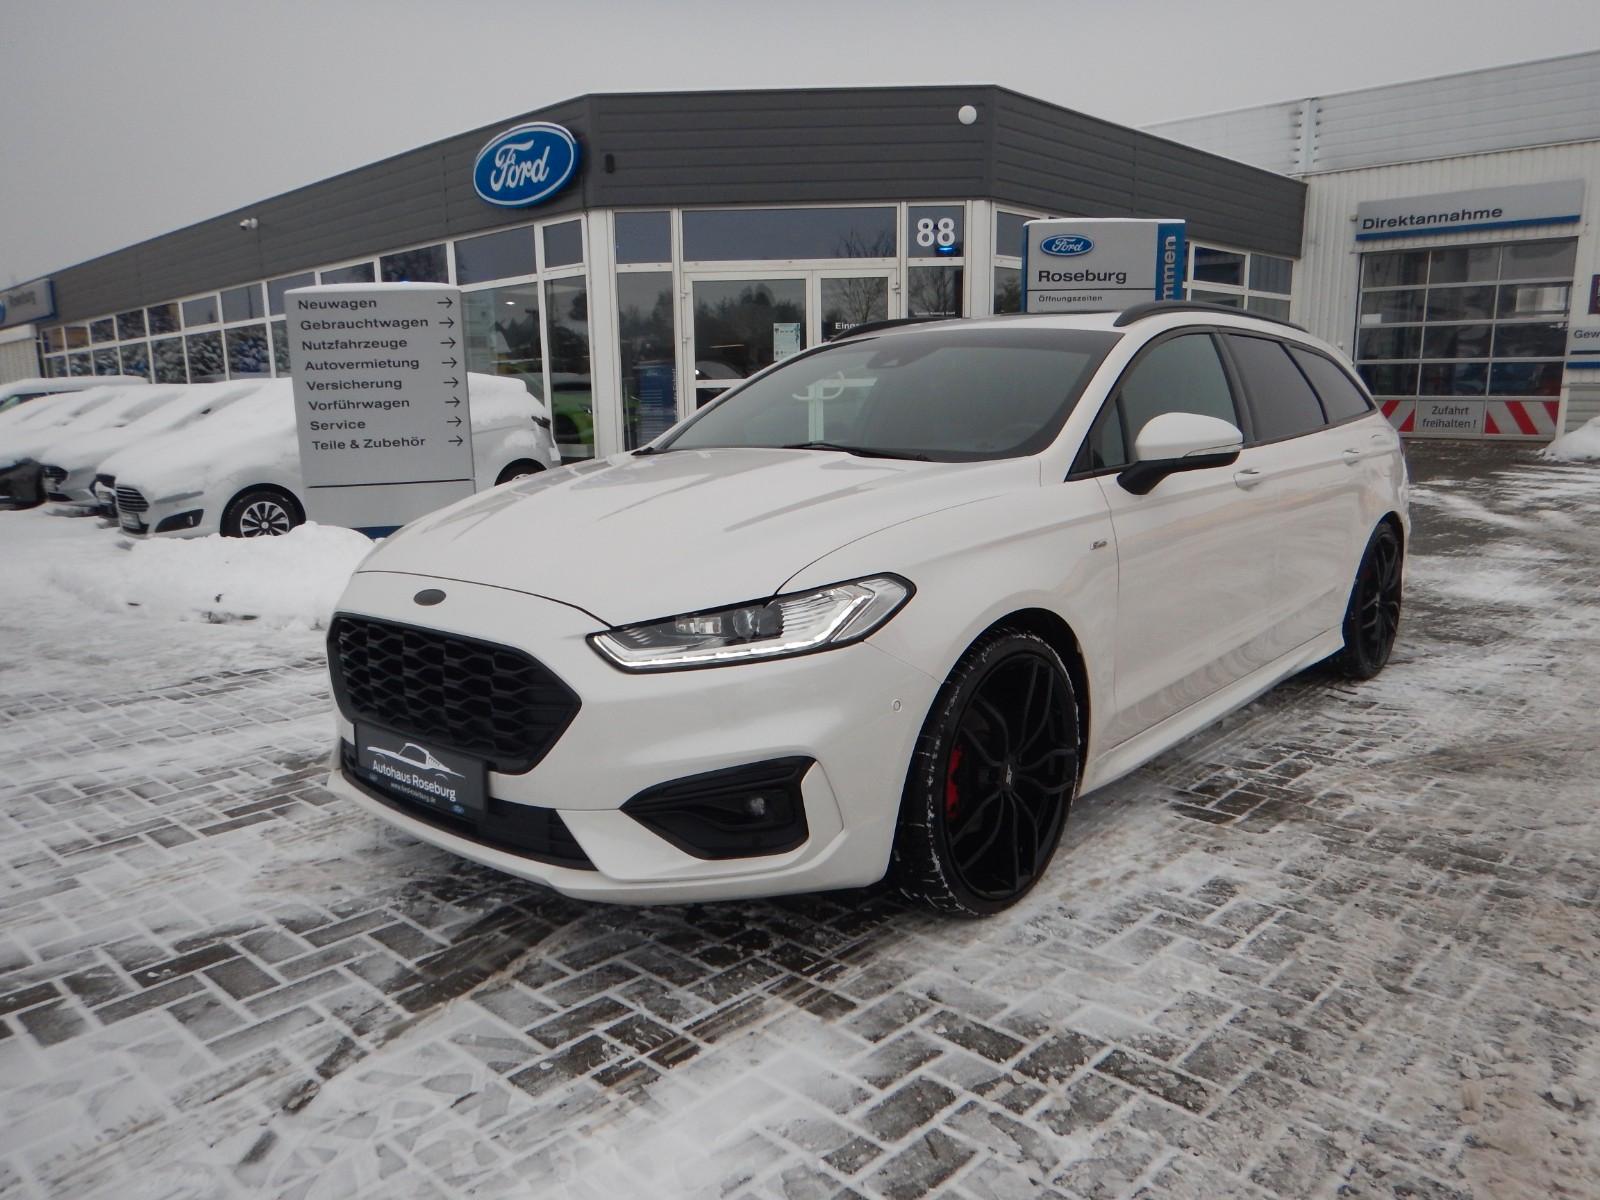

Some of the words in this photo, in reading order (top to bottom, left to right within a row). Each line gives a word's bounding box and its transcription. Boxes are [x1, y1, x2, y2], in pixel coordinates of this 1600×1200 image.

[490, 139, 551, 193] Ford
[1362, 208, 1503, 230] Direktannahme
[916, 217, 956, 248] 88
[1051, 238, 1085, 253] Ford
[1038, 270, 1127, 284] Roseburg
[298, 299, 377, 311] Neuwagen
[300, 318, 429, 331] Gebrauchtwagen
[302, 338, 408, 351] Nutzfahrzeuge
[304, 358, 420, 371] Autovermietung
[306, 379, 403, 391] Versicherung
[308, 399, 410, 411] Vorführwagen
[1431, 405, 1470, 416] Zufahrt
[310, 420, 366, 431] Service
[1422, 418, 1471, 428] freihalten
[312, 440, 346, 451] Teile
[350, 439, 360, 449] &
[363, 436, 426, 449] Zubehör
[372, 760, 412, 784] Autohaus
[412, 774, 457, 802] Roseburg
